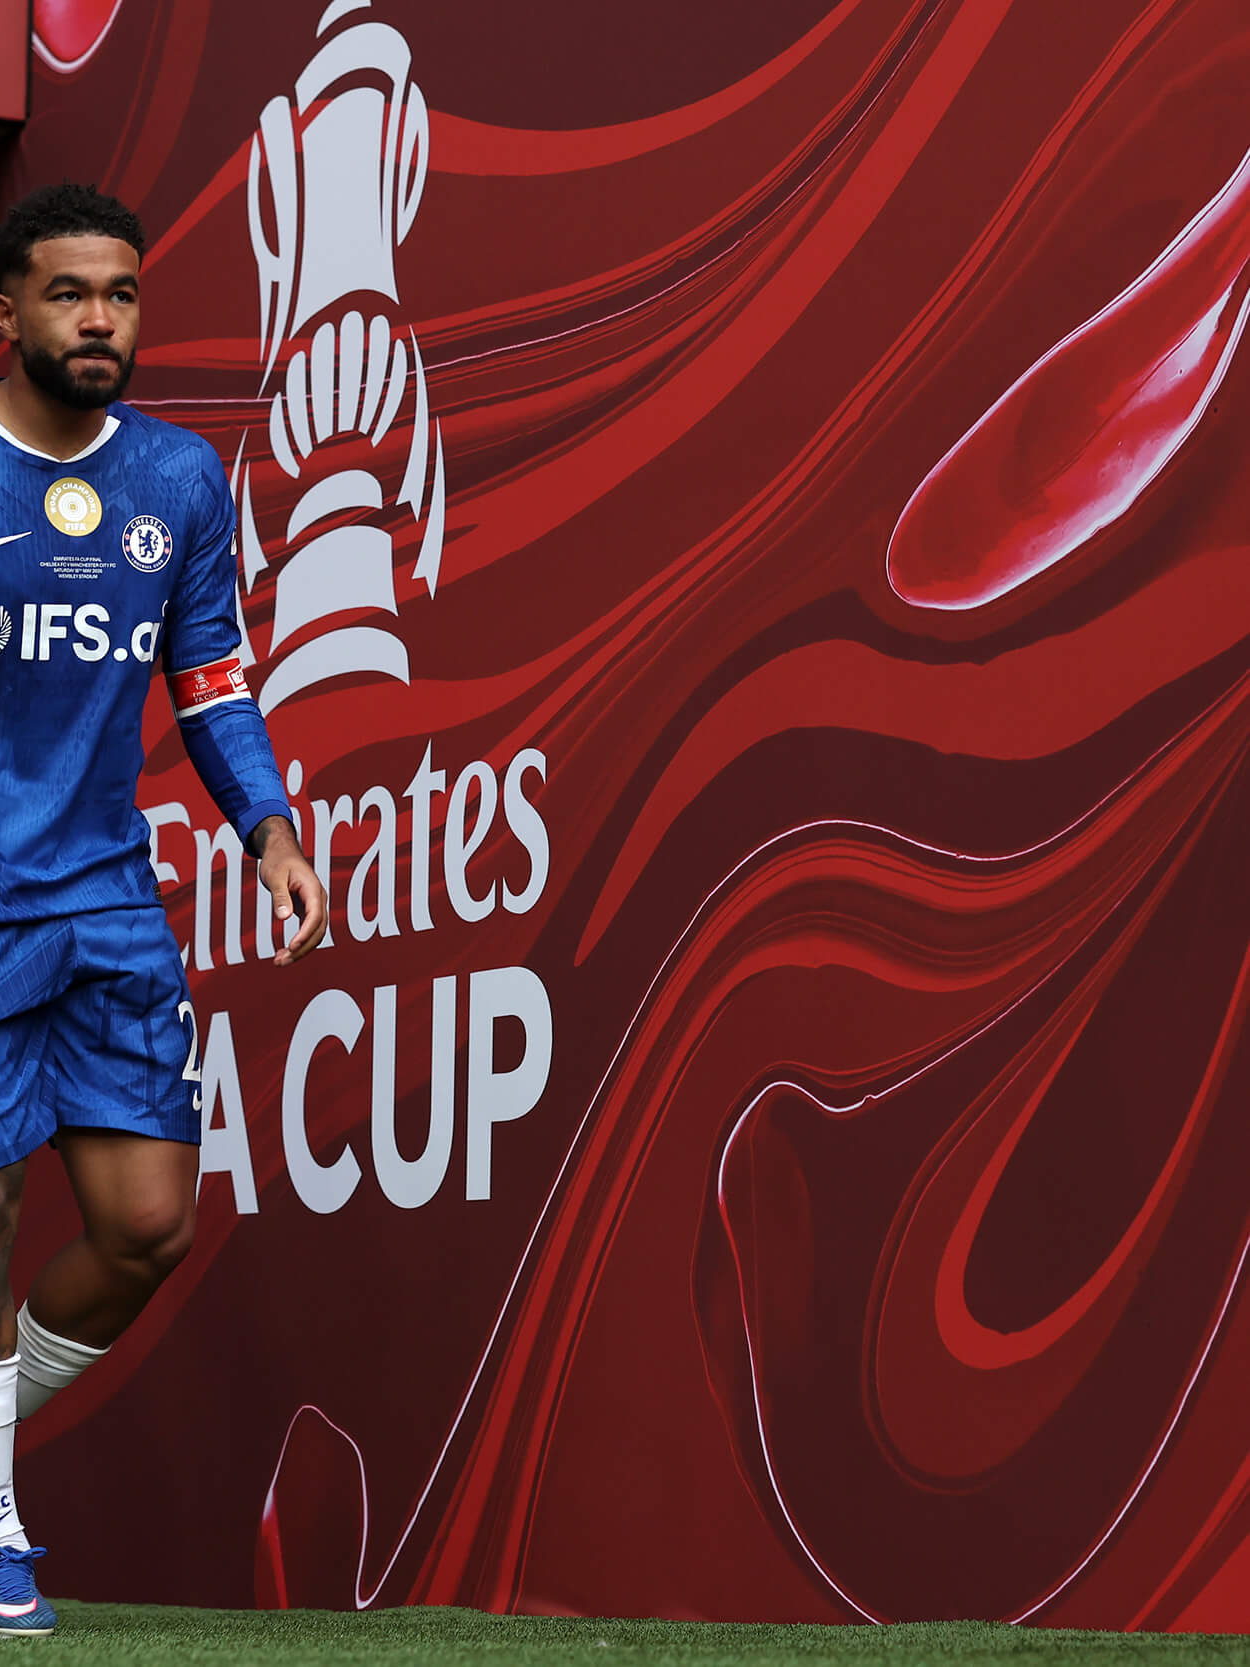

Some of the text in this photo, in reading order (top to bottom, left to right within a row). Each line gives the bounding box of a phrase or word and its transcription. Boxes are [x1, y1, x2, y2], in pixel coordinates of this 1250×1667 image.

[49, 487, 62, 514] WORLD
[64, 522, 87, 532] FIFA
[130, 517, 164, 531] CHELSEA
[20, 600, 167, 662] IFS.a
[196, 965, 553, 1215] A CUP
